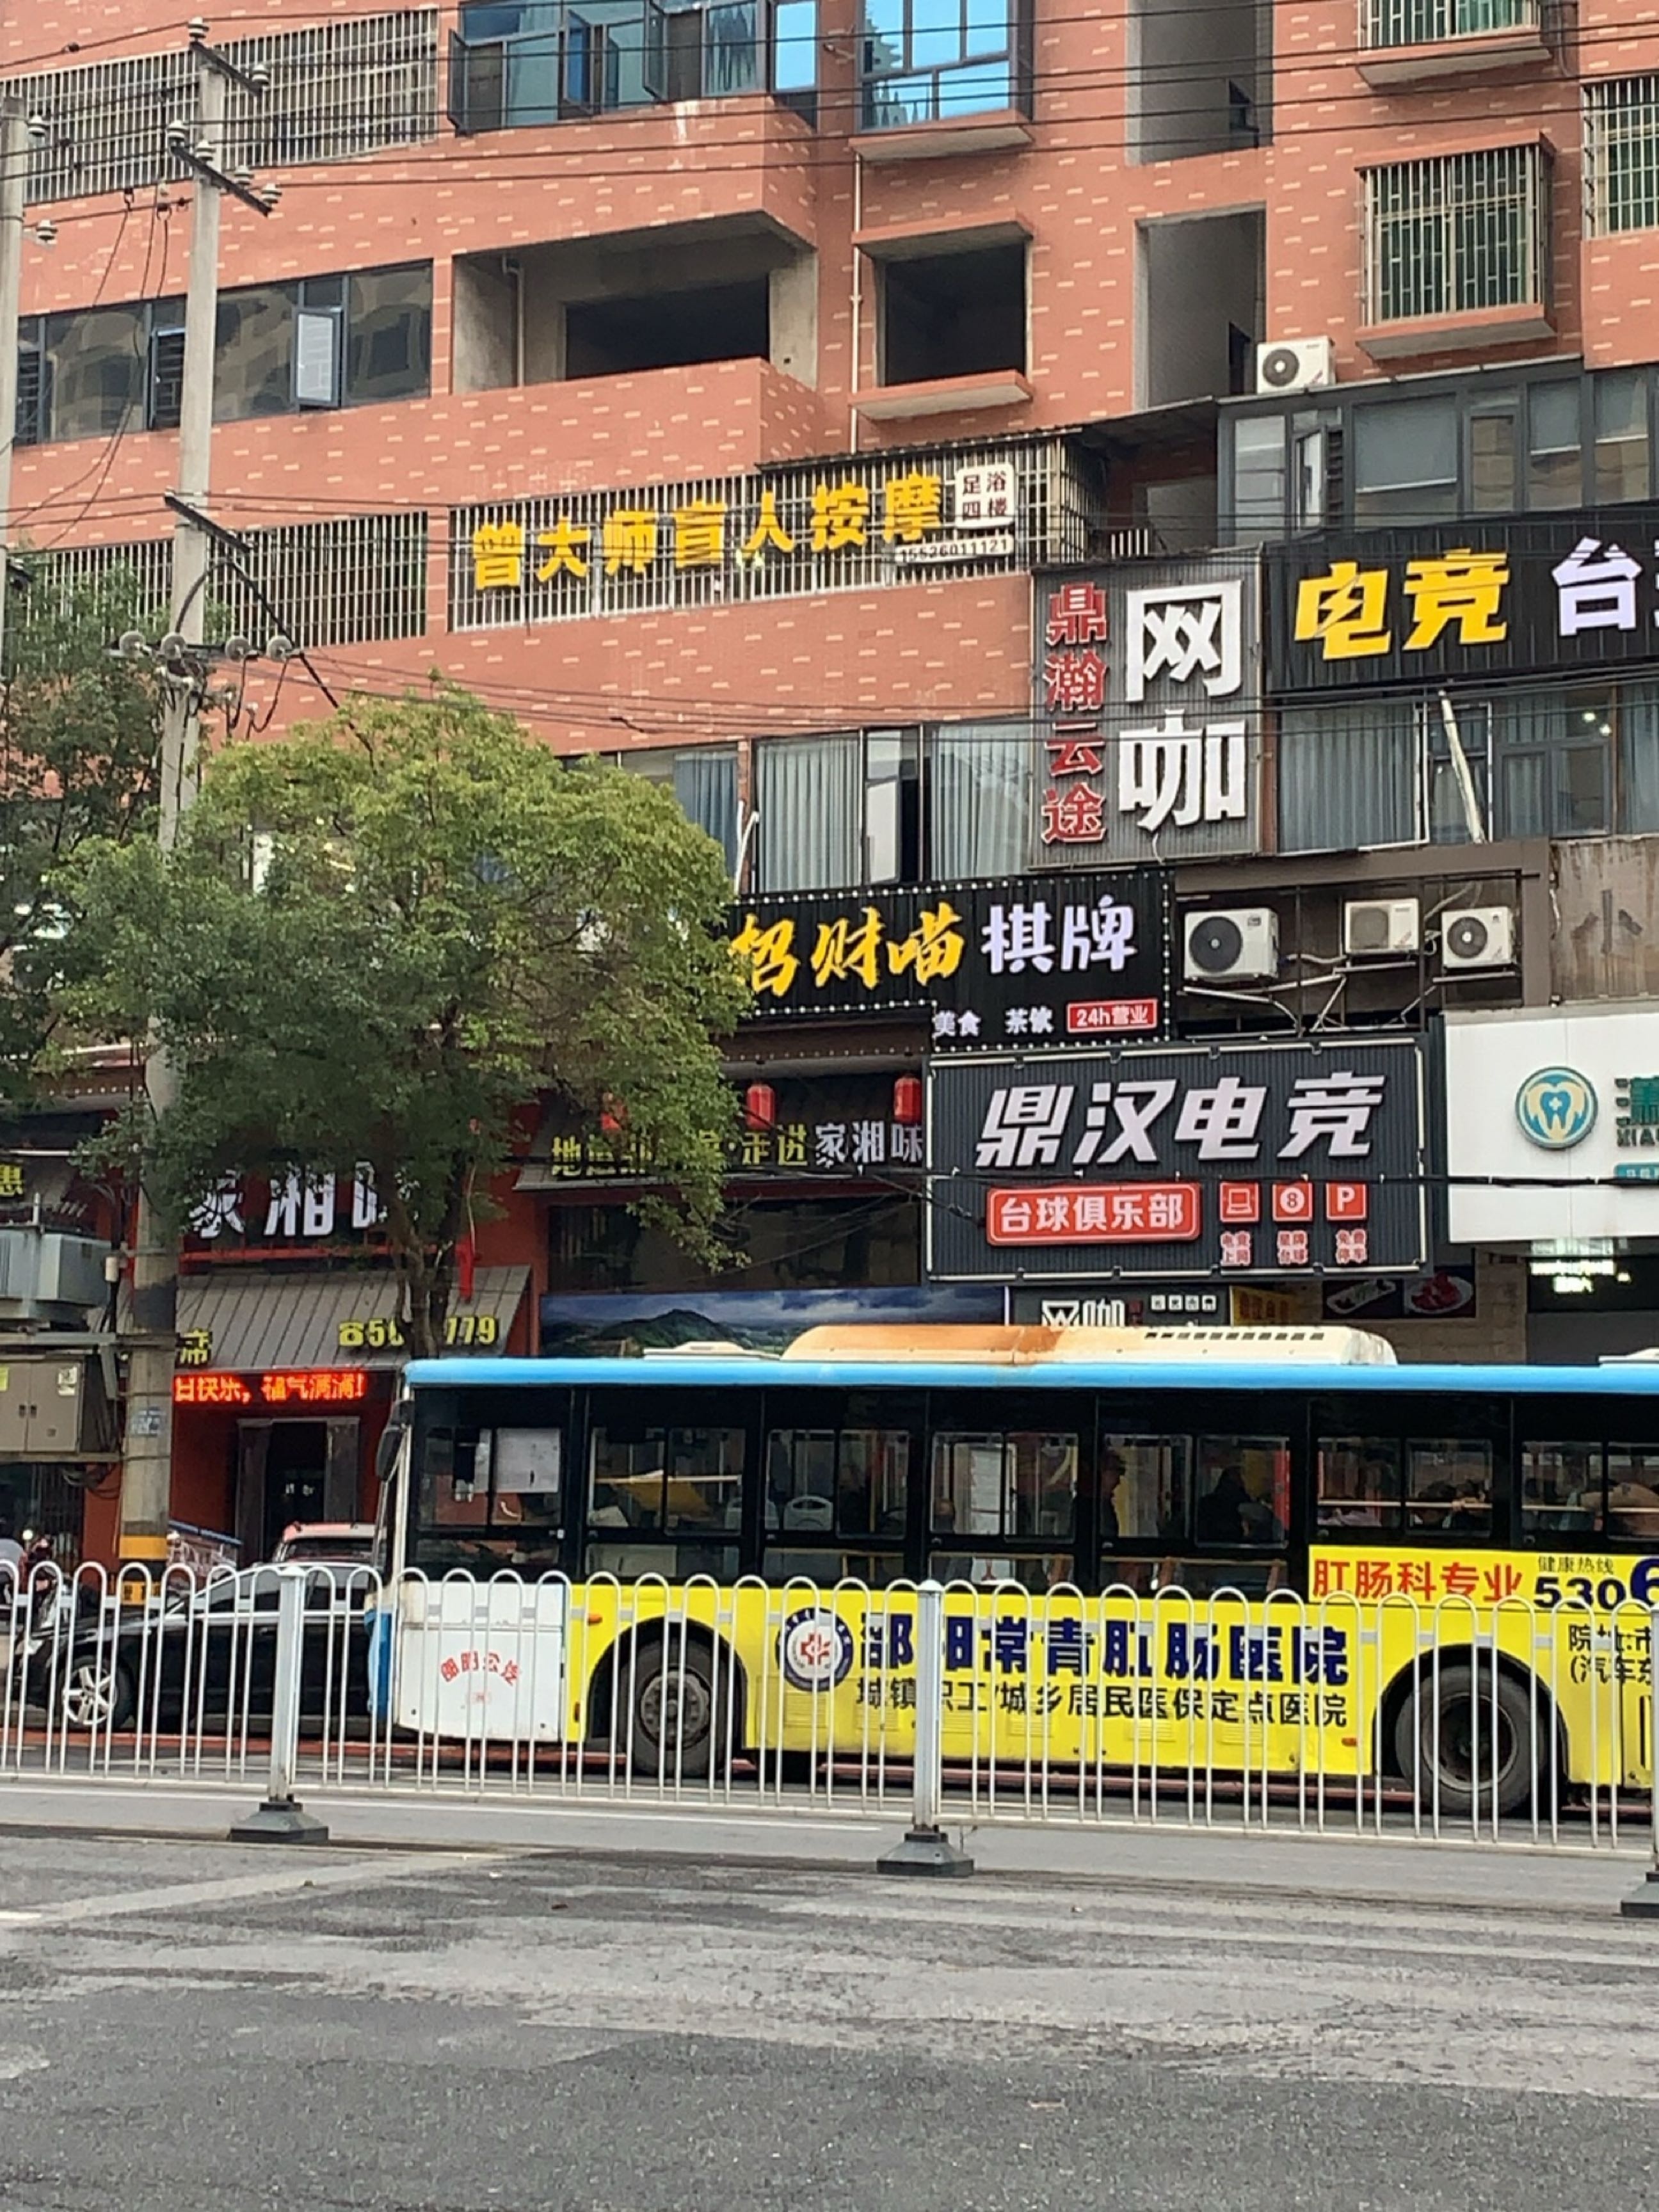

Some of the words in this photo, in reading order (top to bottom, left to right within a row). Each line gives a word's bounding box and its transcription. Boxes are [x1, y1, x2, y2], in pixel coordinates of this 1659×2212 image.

[962, 470, 1007, 496] 足浴
[962, 497, 1007, 521] 四楼
[473, 471, 942, 591] 曾大师盲人按摩
[1294, 547, 1511, 661] 电竞
[1551, 536, 1659, 637] 台
[1040, 582, 1108, 847] 鼎瀚云途
[1118, 578, 1249, 833] 网咖
[981, 895, 1139, 975] 棋牌
[933, 1009, 981, 1038] 美食
[1075, 1005, 1149, 1027] 24h营业
[974, 1070, 1387, 1167] 鼎汉电竞
[1617, 1128, 1659, 1146] XIA
[1000, 1192, 1185, 1234] 台球俱乐部
[1313, 1558, 1523, 1602] 肛肠科专业
[1537, 1556, 1614, 1575] 健康热线
